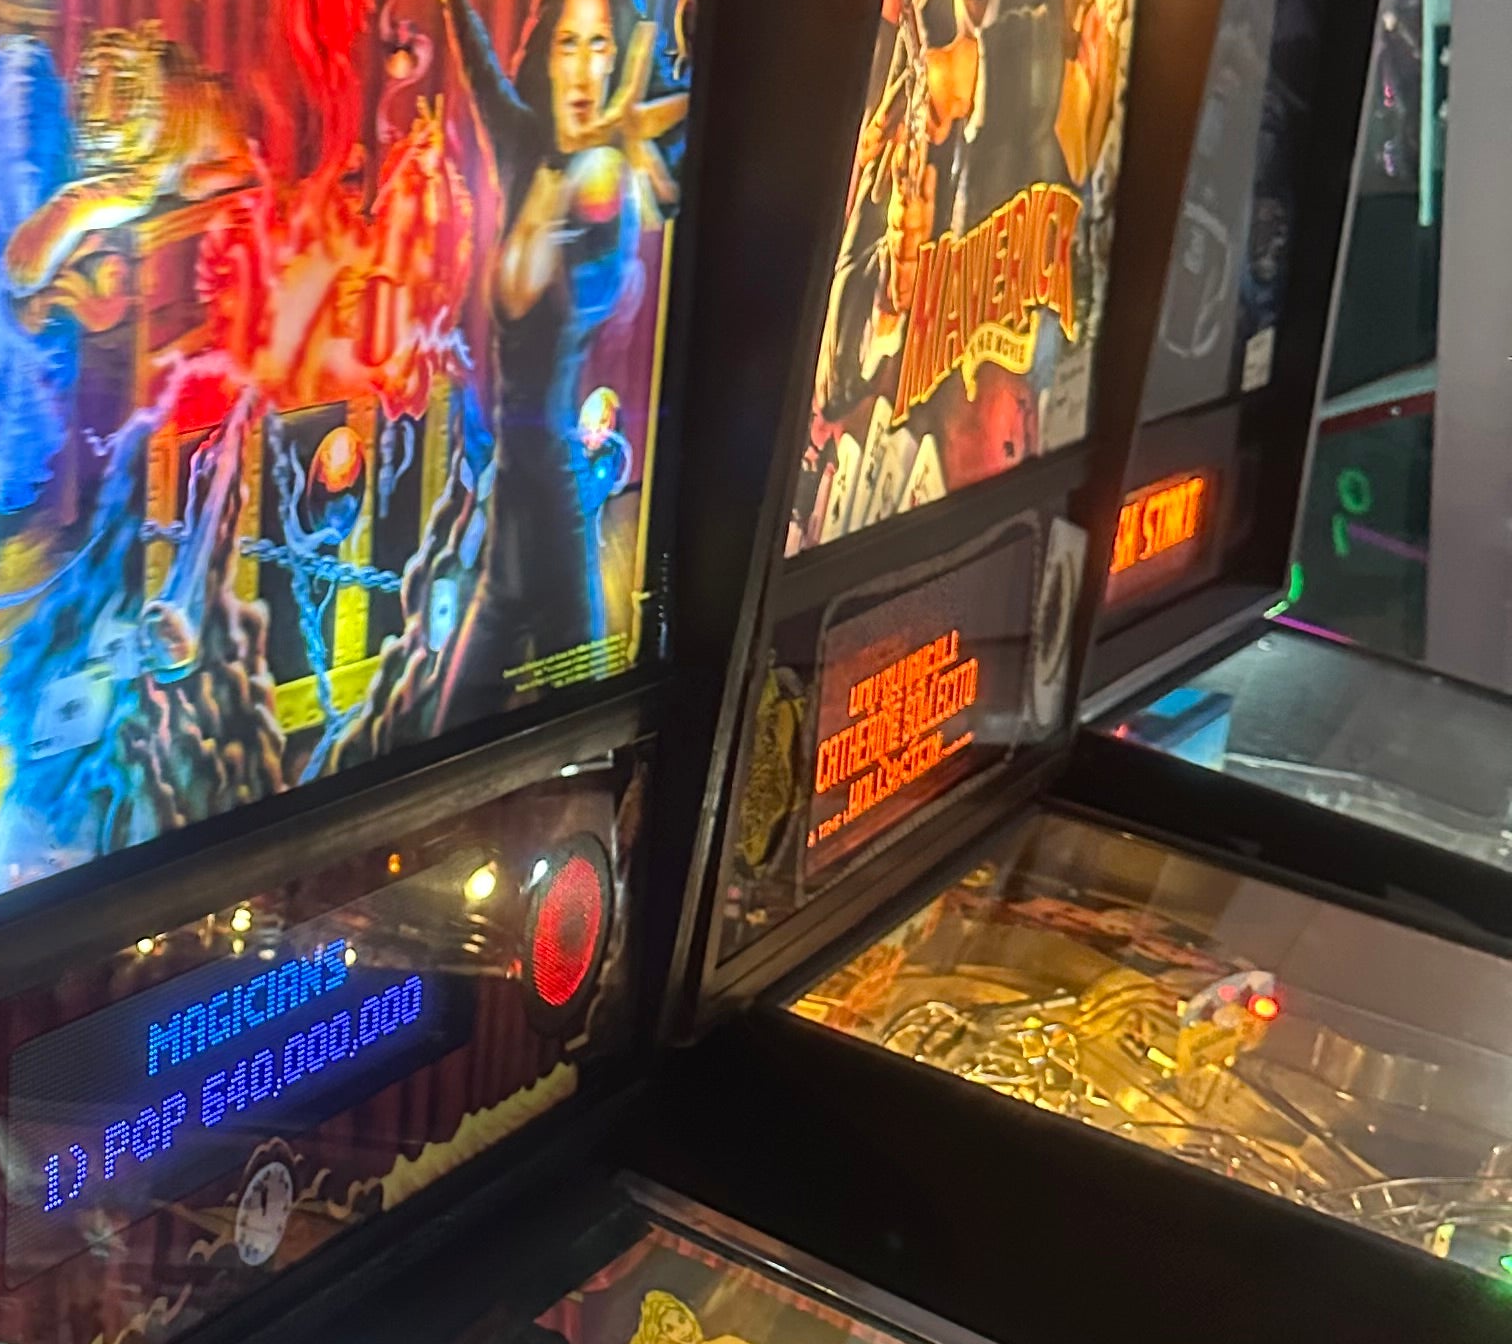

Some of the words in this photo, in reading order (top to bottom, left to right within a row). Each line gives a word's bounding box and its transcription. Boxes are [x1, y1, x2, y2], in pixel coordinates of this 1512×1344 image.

[891, 181, 1083, 427] MAVERICK
[44, 1143, 88, 1213] 1)
[104, 1091, 187, 1180] POP
[201, 975, 423, 1128] 640,000,000
[147, 938, 349, 1076] MAGICIANS
